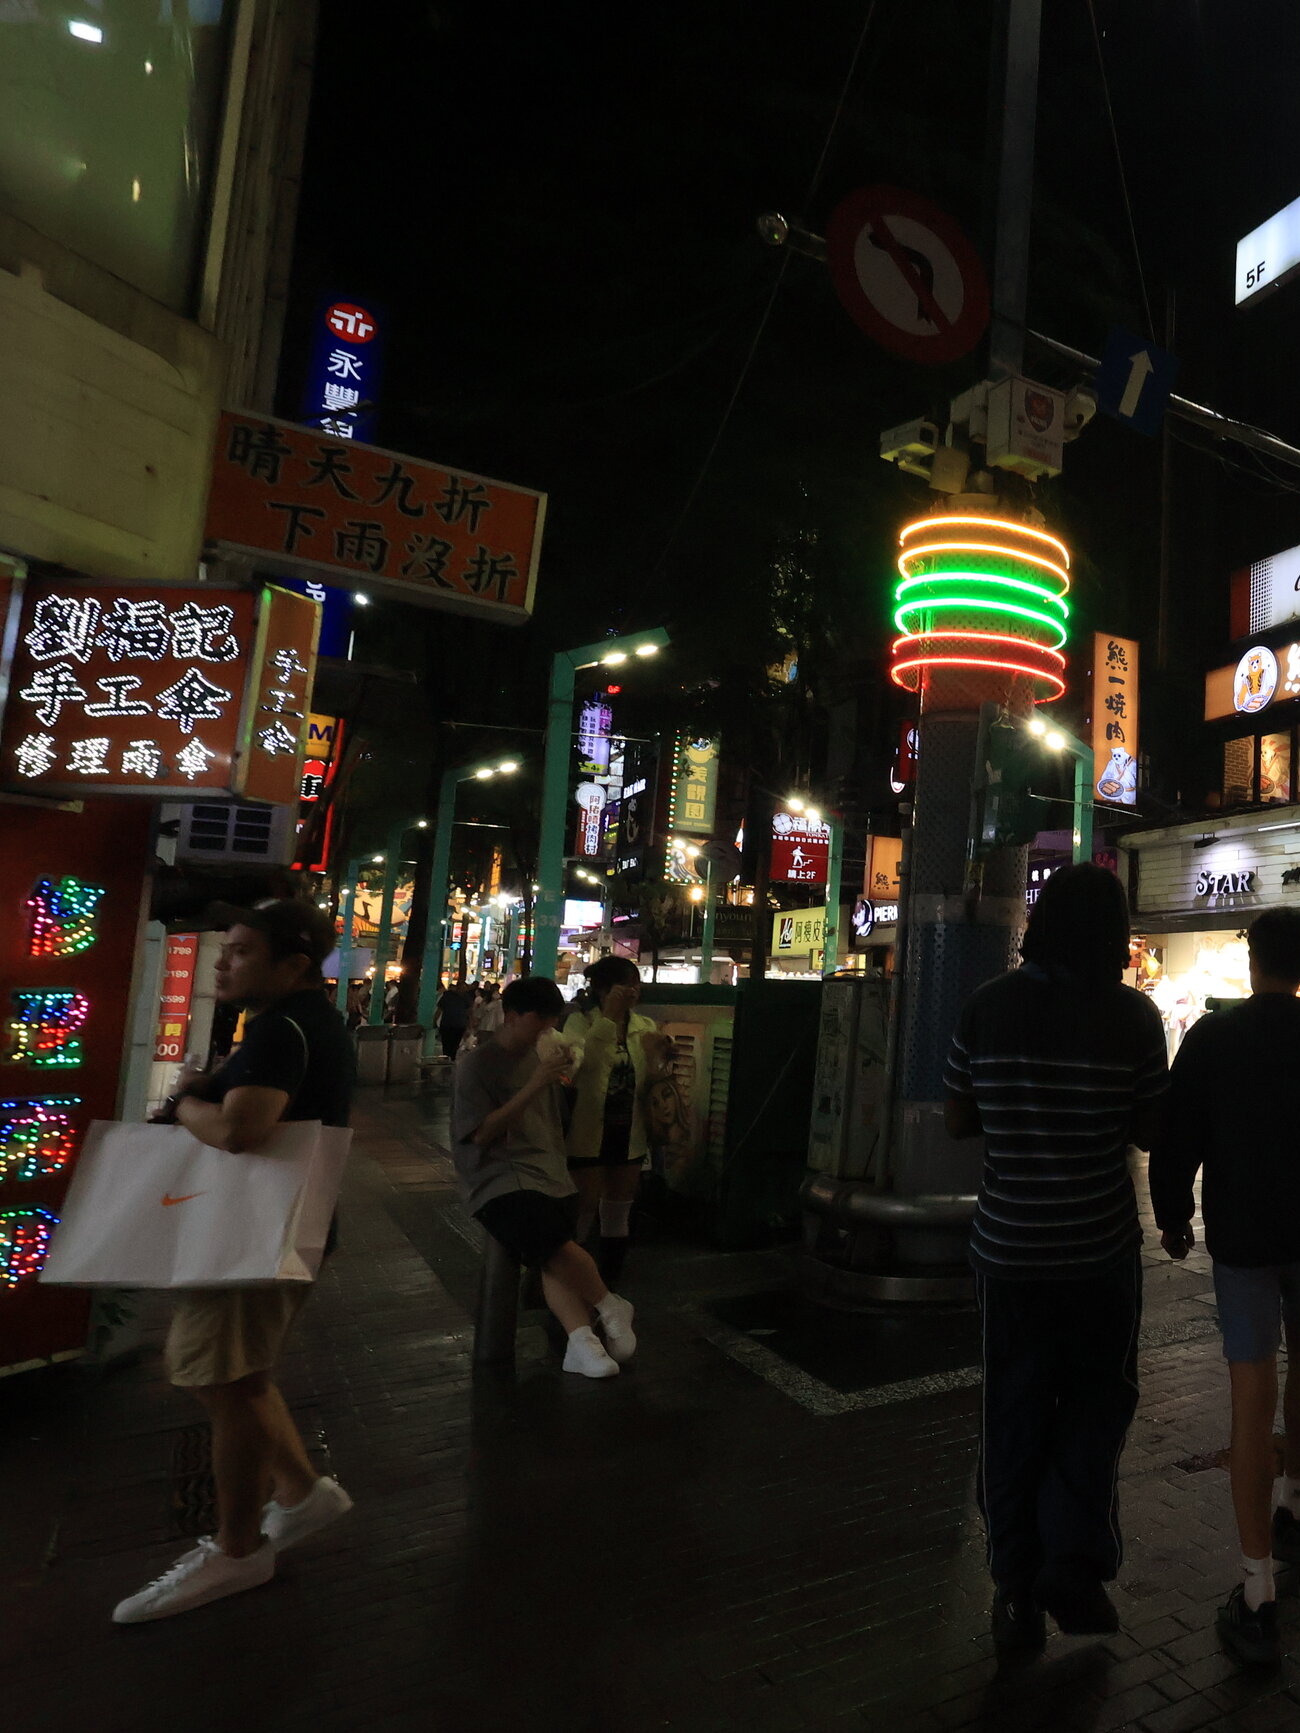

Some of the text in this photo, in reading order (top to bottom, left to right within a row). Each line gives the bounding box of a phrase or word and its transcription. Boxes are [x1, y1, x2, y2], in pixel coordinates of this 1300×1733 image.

[1246, 261, 1266, 289] 5F
[227, 422, 491, 535] 晴天九折
[19, 661, 233, 735] 手工傘
[1195, 870, 1251, 896] STAR
